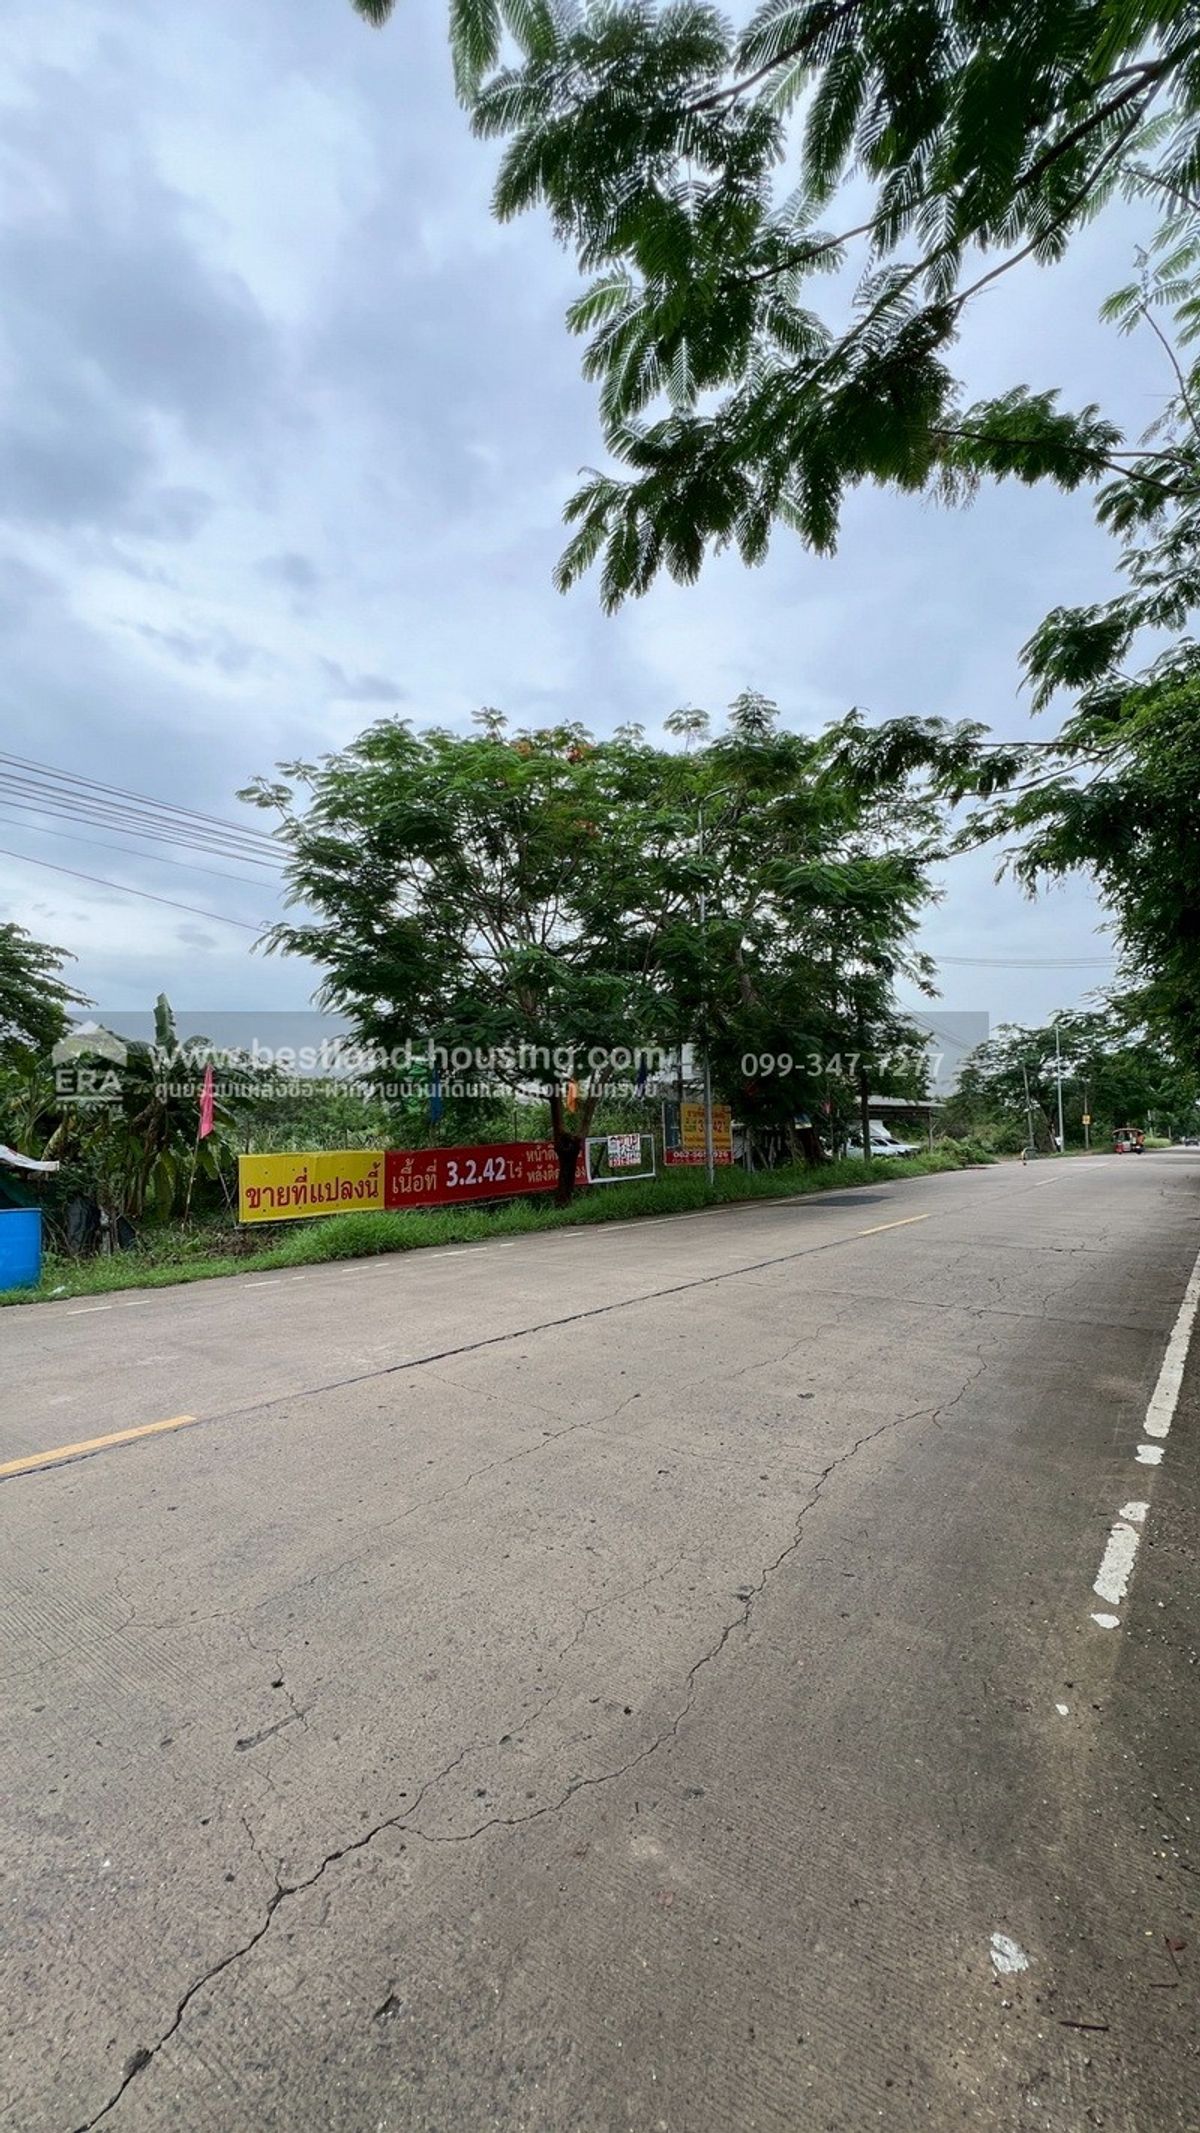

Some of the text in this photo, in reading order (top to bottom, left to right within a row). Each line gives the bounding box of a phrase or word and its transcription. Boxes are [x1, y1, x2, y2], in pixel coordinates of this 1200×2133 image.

[245, 1162, 381, 1209] ขายที่แปลงนี้
[392, 1156, 524, 1194] เนื้อที่ 3.2.42 ไร่
